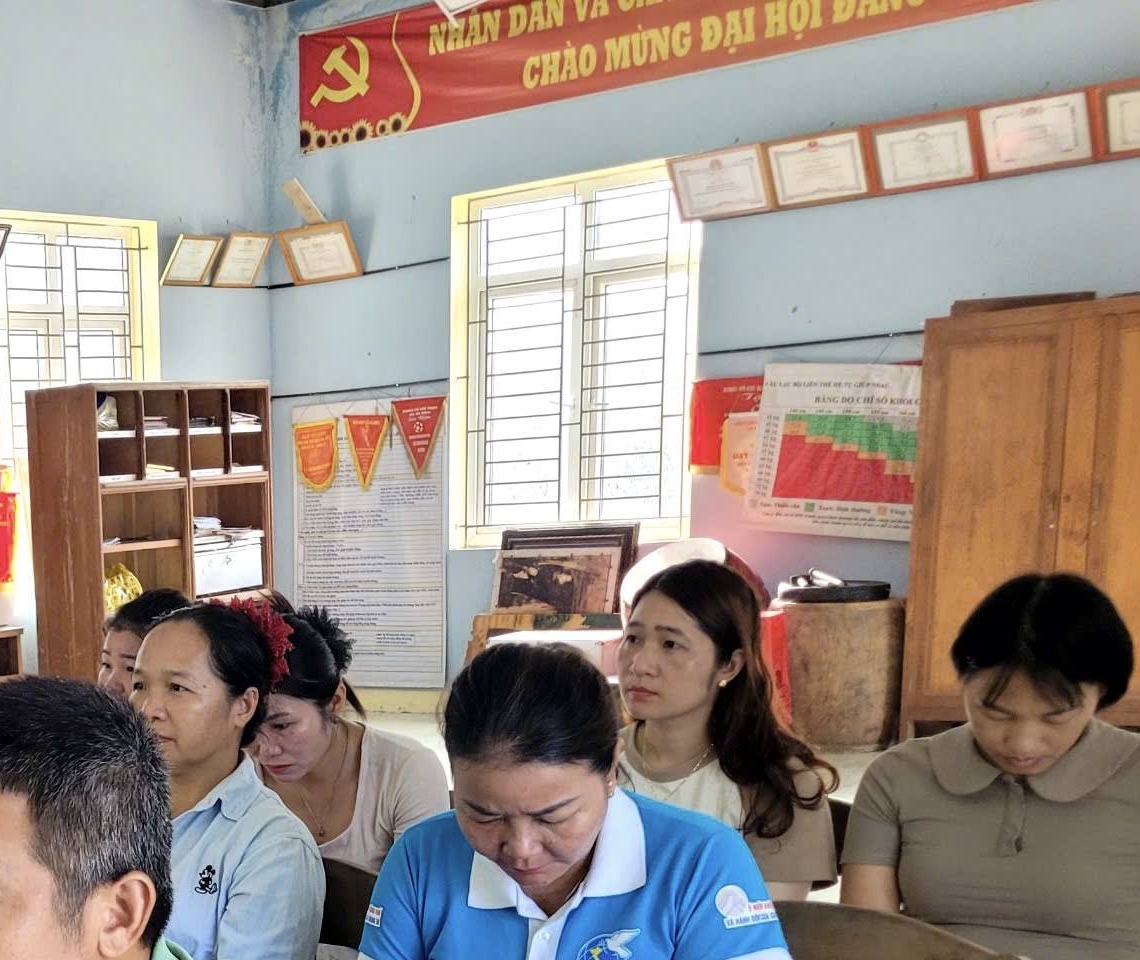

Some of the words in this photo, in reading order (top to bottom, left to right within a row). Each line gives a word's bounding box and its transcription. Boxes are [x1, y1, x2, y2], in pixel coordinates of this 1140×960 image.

[522, 40, 597, 89] CHÀO
[604, 21, 693, 73] MỪNG
[701, 7, 755, 54] ĐẠI
